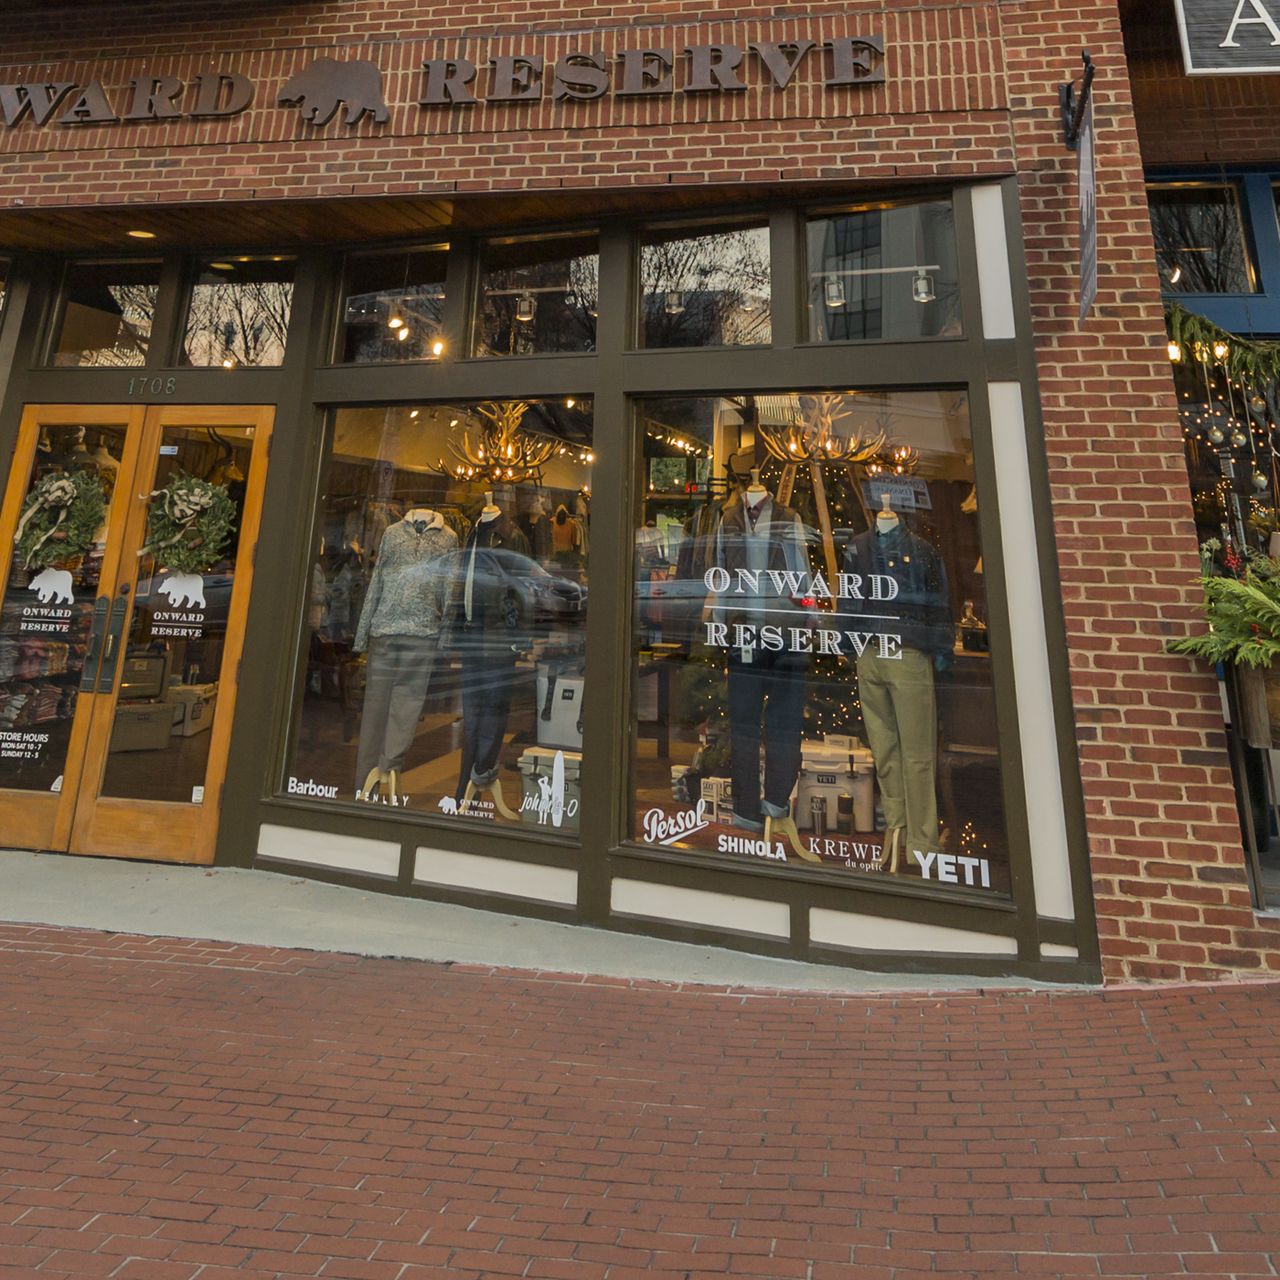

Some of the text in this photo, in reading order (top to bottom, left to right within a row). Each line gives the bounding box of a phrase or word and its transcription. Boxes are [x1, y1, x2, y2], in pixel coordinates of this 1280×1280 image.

[419, 35, 886, 105] RESERVE
[128, 377, 176, 395] 1708
[704, 567, 899, 601] ONWARD
[23, 607, 72, 618] ONWARD
[153, 611, 205, 622] ONWARD
[20, 622, 69, 633] RESERVE
[151, 627, 203, 637] RESERVE
[704, 622, 903, 660] RESERVE
[23, 733, 49, 742] HOURS
[818, 776, 835, 784] YETI
[288, 776, 338, 799] Barbour
[460, 799, 495, 809] ONWARD
[460, 810, 495, 819] RESERVE
[643, 798, 709, 844] Persol
[718, 834, 787, 861] SHINOLA
[809, 837, 883, 862] KREWE
[845, 859, 857, 868] du
[913, 850, 990, 888] YETI
